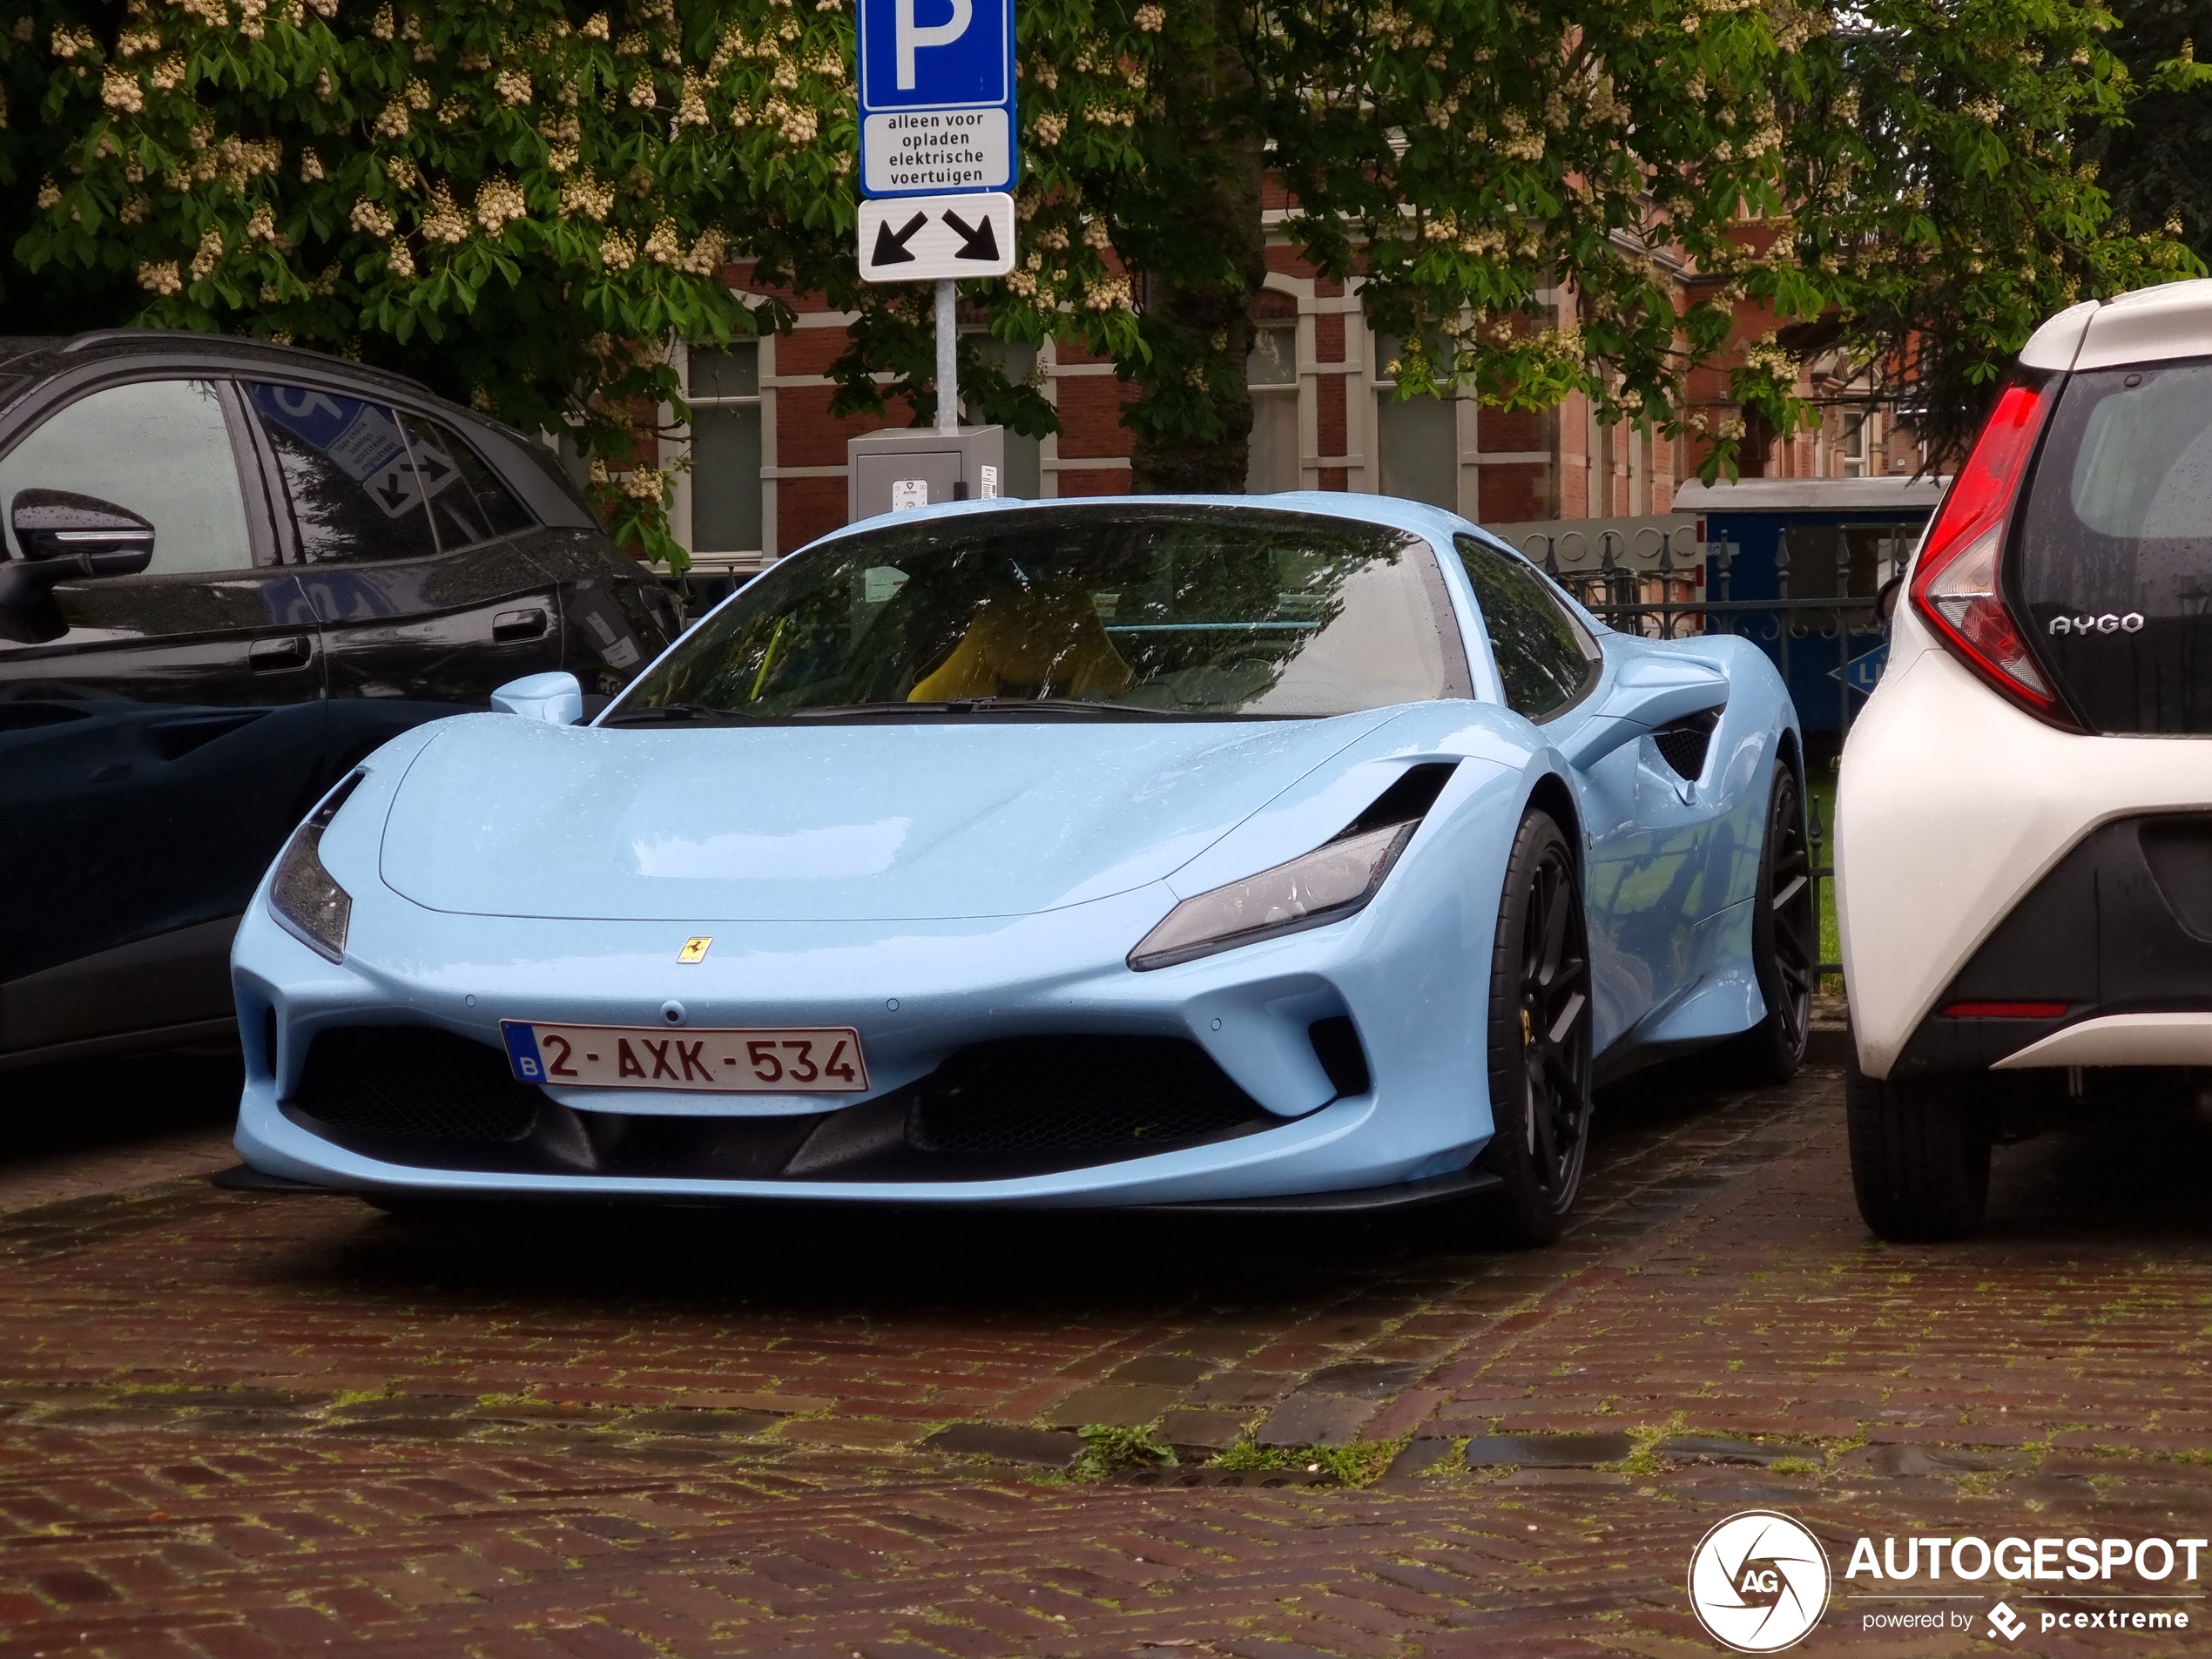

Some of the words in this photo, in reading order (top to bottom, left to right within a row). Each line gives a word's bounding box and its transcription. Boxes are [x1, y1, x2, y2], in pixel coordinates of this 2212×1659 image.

[895, 0, 973, 90] P
[888, 114, 940, 129] alleen
[945, 114, 983, 126] voor
[902, 131, 969, 150] opladen
[889, 148, 984, 166] elektrische
[890, 168, 982, 185] voertuigen
[2049, 612, 2144, 636] AYGO
[520, 1056, 539, 1076] B
[542, 1034, 855, 1082] 2-AXK-534
